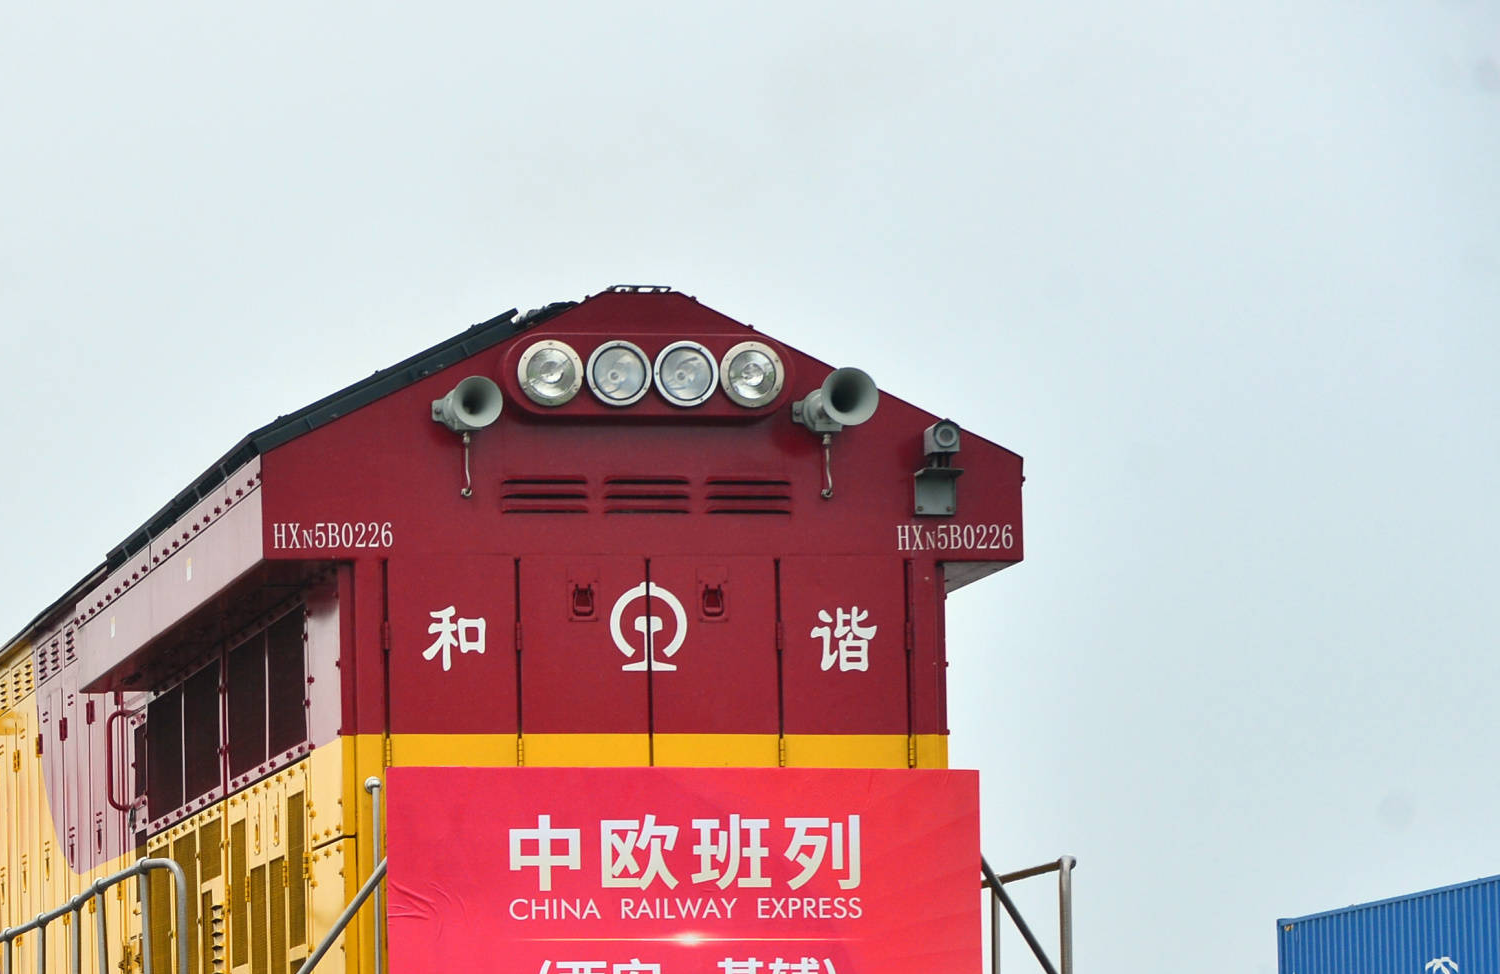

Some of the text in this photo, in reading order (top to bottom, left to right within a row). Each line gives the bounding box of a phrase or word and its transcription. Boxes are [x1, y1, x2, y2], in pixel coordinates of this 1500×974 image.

[422, 605, 879, 672] 和 谐
[508, 814, 862, 891] 中欧班列
[509, 897, 863, 921] CHINA RAILWAY EXPRESS
